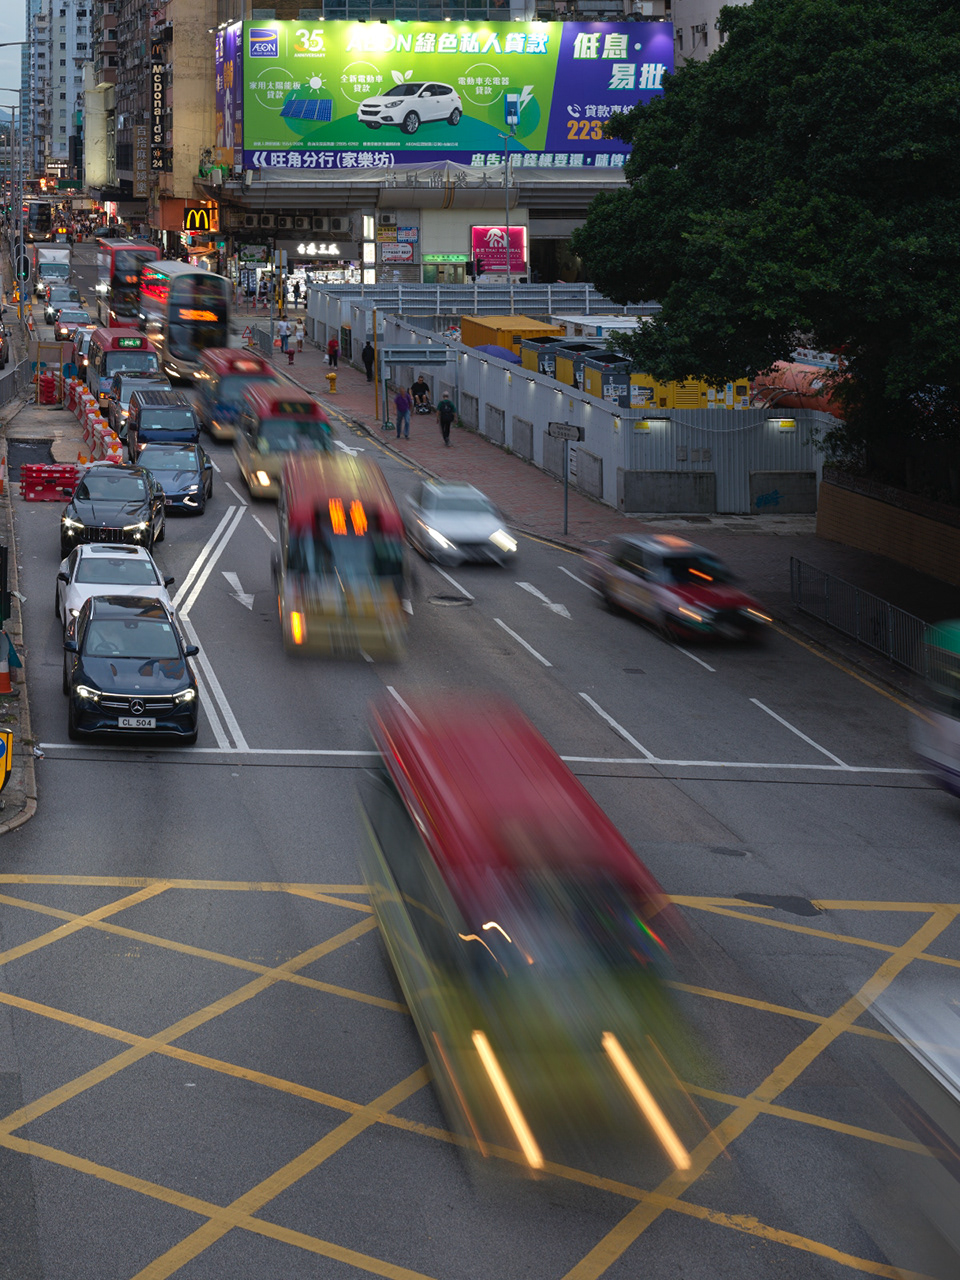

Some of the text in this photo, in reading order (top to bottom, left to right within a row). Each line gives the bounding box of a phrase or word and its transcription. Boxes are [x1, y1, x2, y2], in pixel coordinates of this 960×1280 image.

[608, 63, 666, 90] 易批
[353, 84, 370, 93] 貸款
[475, 86, 493, 95] 貸款
[267, 91, 284, 99] 貸款
[152, 65, 164, 143] McDonald's
[135, 719, 153, 727] 504
